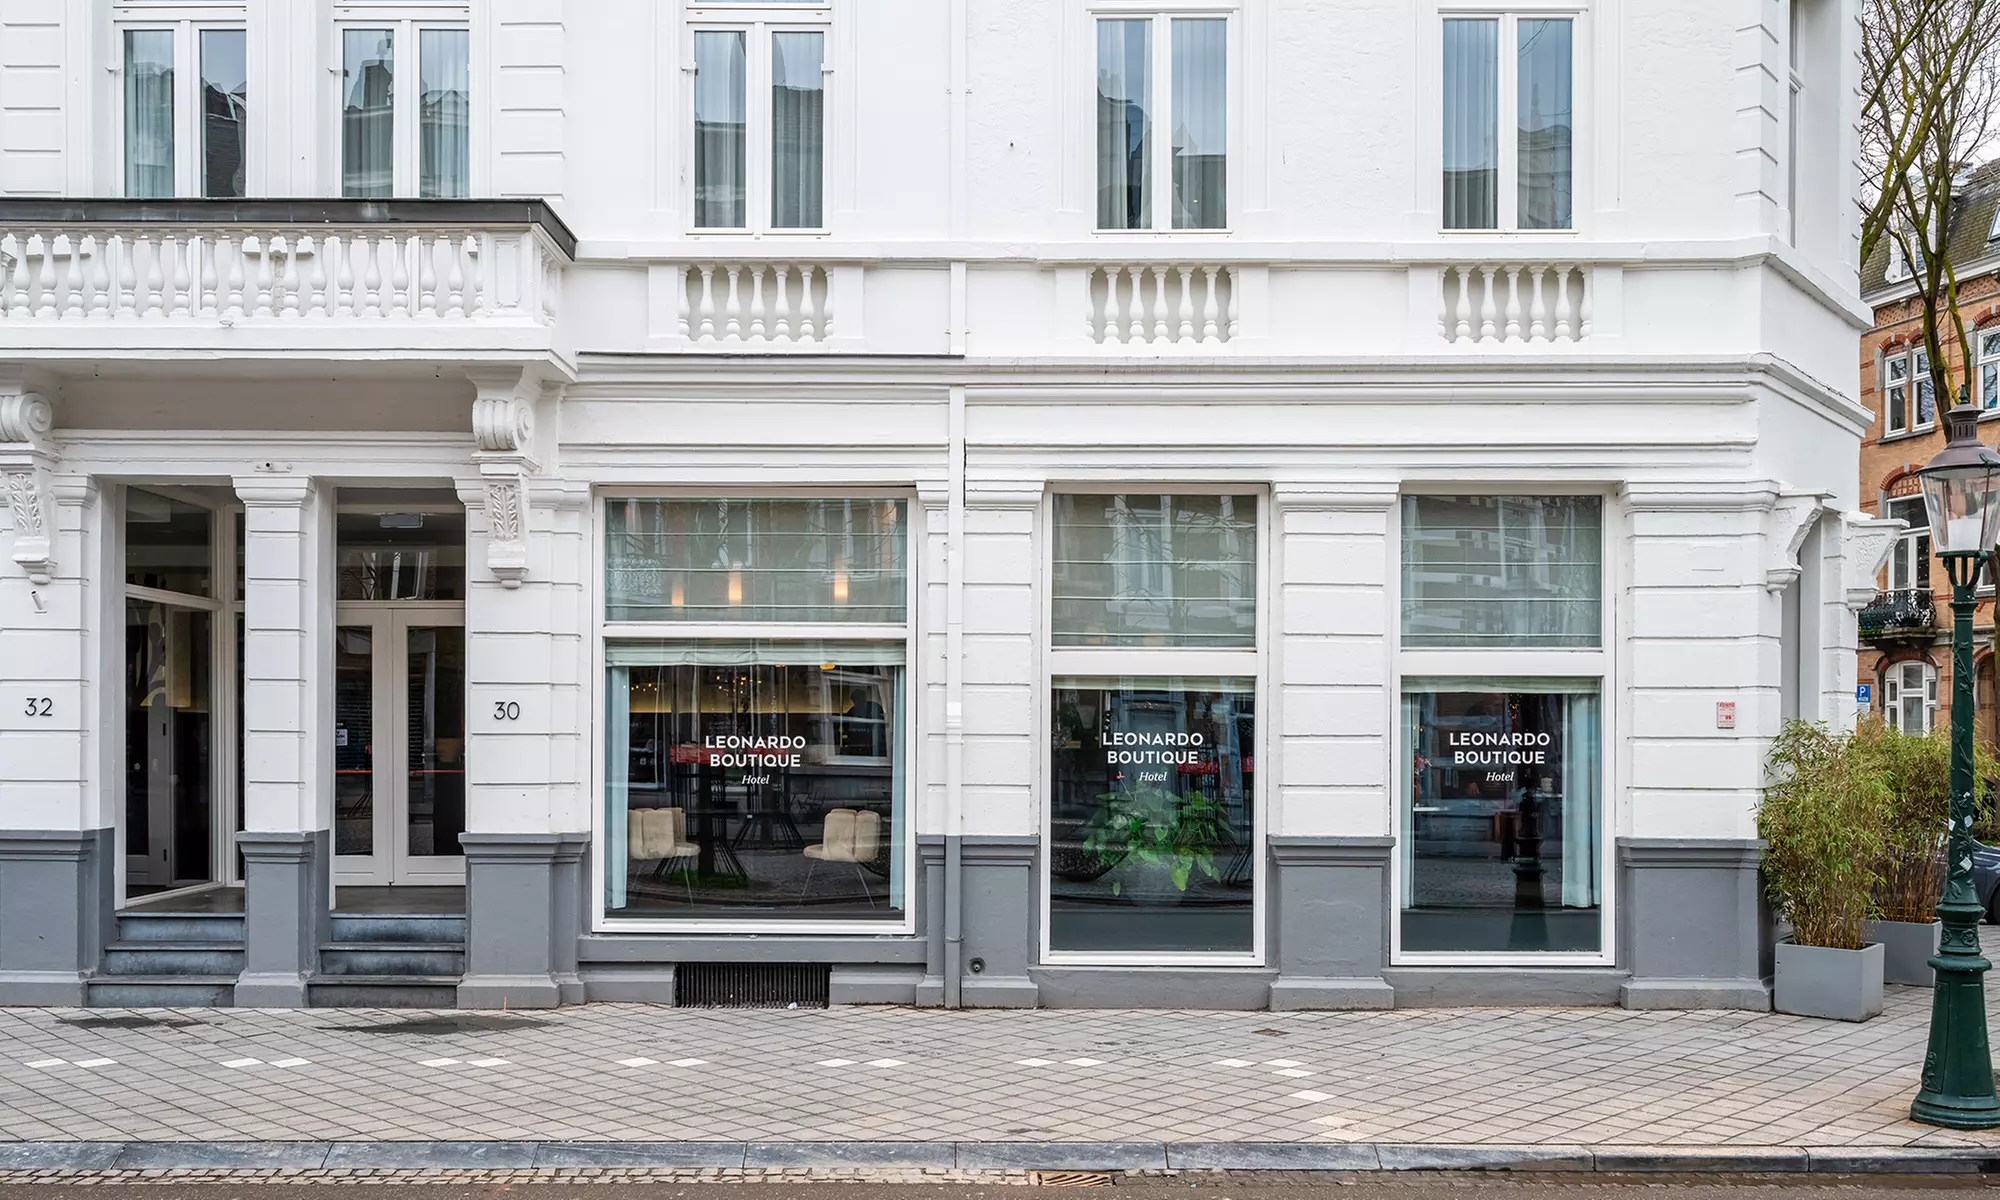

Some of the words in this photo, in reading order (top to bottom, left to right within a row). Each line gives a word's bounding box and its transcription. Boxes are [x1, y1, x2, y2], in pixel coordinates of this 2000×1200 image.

[25, 697, 53, 717] 32
[494, 701, 520, 720] 30
[706, 735, 807, 749] LEONARDO
[1102, 732, 1203, 746] LEONARDO
[1449, 732, 1550, 746] LEONARDO
[711, 753, 802, 767] BOUTIQUE
[1107, 750, 1198, 764] BOUTIQUE
[1454, 750, 1545, 764] BOUTIQUE
[741, 772, 771, 785] Hotel
[1137, 769, 1167, 782] Hotel
[1484, 769, 1514, 782] Hotel
